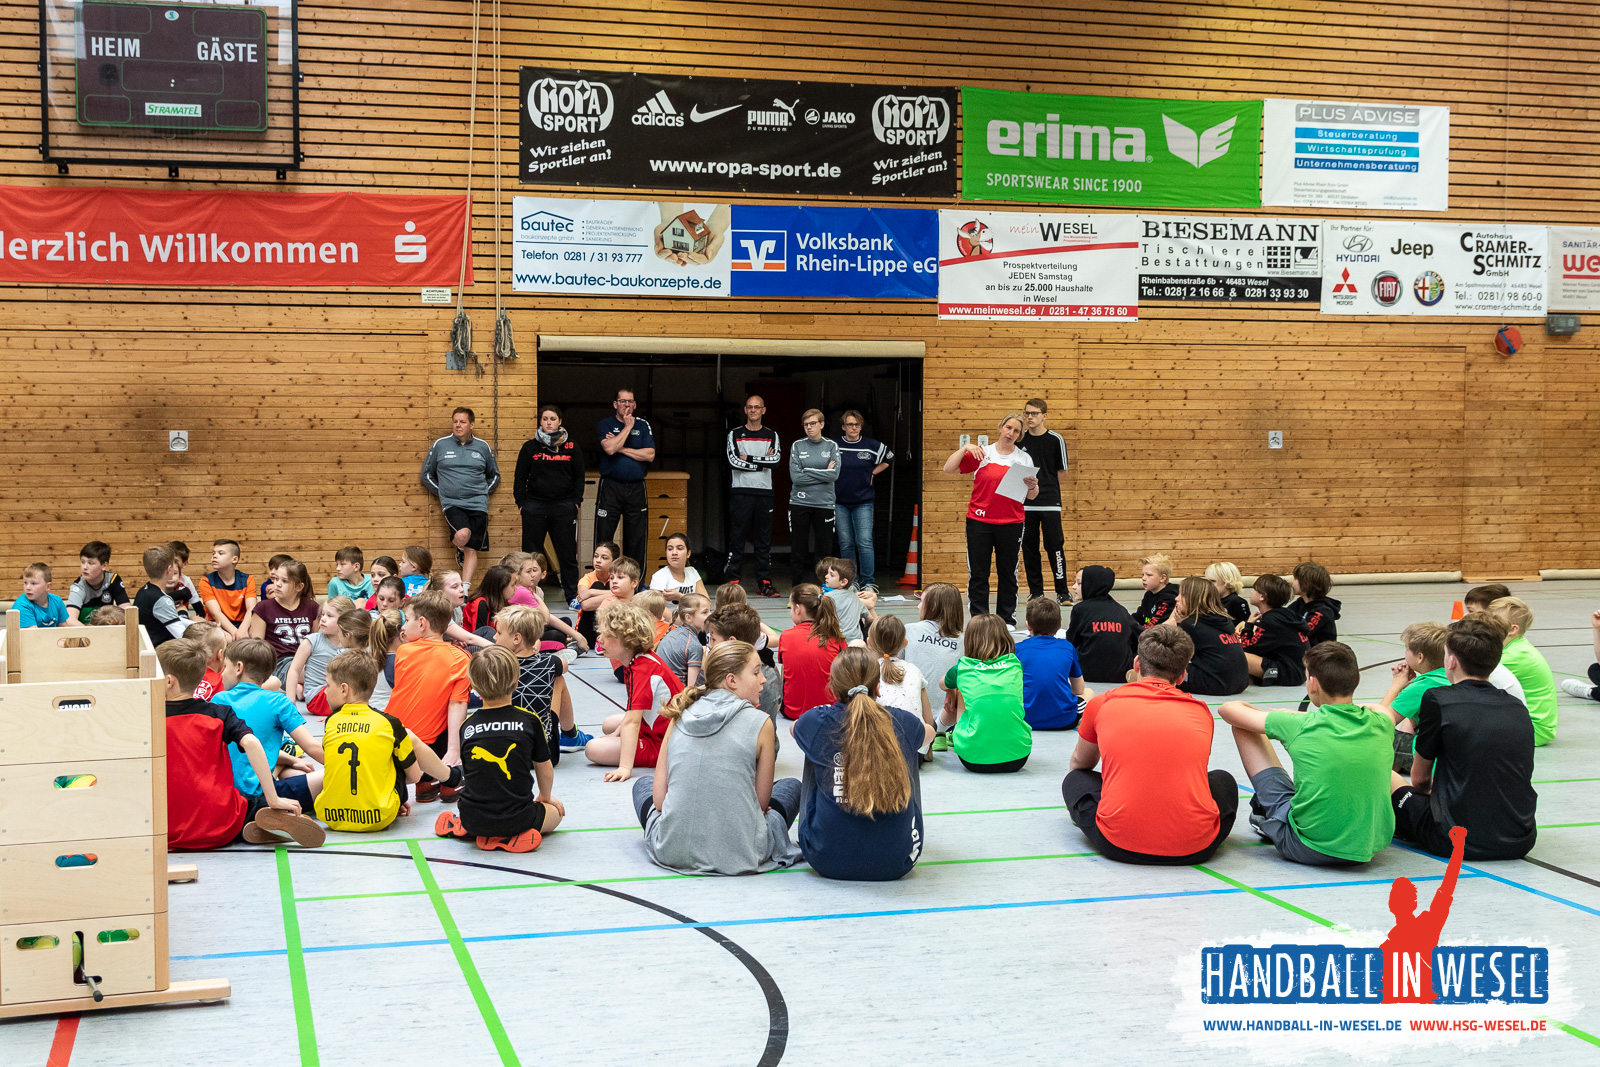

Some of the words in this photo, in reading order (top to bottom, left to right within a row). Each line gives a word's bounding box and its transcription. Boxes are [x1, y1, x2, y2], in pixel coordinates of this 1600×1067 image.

[91, 36, 141, 58] HEIM
[196, 37, 258, 63] GÄSTE
[631, 112, 684, 127] adidas
[822, 111, 856, 124] JAKO
[1299, 107, 1346, 121] PLUS
[1351, 109, 1416, 124] ADVISE
[543, 115, 598, 133] SPORT
[885, 129, 937, 146] SPORT
[986, 113, 1146, 162] erima
[1317, 129, 1398, 142] Steuerberatung
[529, 143, 558, 158] Wir
[560, 138, 606, 155] ziehen
[1307, 144, 1407, 157] Wirtschaftsprüfung
[528, 155, 587, 174] Sportler
[650, 159, 841, 179] www.ropa-sport.de
[872, 158, 900, 171] Wir
[901, 151, 943, 166] ziehen
[1296, 159, 1417, 172] Unternehmensberatung
[871, 168, 926, 185] Sportler
[927, 161, 948, 174] an!
[986, 172, 1069, 190] SPORTSWEAR
[1072, 177, 1108, 192] SINCE
[1112, 179, 1142, 193] 1900
[521, 218, 574, 234] bautec
[1009, 224, 1040, 235] mein
[1142, 220, 1320, 242] BIESEMANN
[520, 234, 556, 243] baukonzepte
[796, 232, 894, 251] Volksbank
[1460, 232, 1533, 254] CRAMER-
[0, 232, 129, 262] erzlich
[139, 233, 358, 263] Willkommen
[1390, 238, 1434, 259] Jeep
[521, 249, 558, 261] Telefon
[563, 251, 586, 262] 0281
[597, 252, 608, 262] 31
[611, 253, 623, 262] 93
[625, 253, 643, 263] 777
[1142, 257, 1264, 271] Bestattungen
[1336, 254, 1380, 263] HYUNDAI
[796, 254, 907, 276] Rhein-Lippe
[912, 257, 937, 273] eG
[1003, 261, 1078, 272] Prospektverteilung
[1473, 254, 1541, 276] SCHMITZ
[515, 272, 722, 291] www.bautec-baukonzepte.de
[1008, 272, 1036, 280] JEDEN
[1038, 273, 1073, 282] Samstag
[1142, 277, 1206, 286] Rheinbabenstraße
[1247, 279, 1269, 287] Wesel
[997, 283, 1010, 291] bis
[1024, 283, 1053, 292] 25.000
[1055, 284, 1094, 292] Haushalte
[1142, 287, 1162, 297] Tel.:
[1164, 287, 1188, 297] 0281
[1190, 288, 1197, 297] 2
[1199, 288, 1211, 297] 16
[1212, 288, 1224, 298] 66
[1229, 288, 1238, 298] &
[1245, 288, 1267, 298] 0281
[1269, 289, 1282, 298] 33
[1283, 289, 1296, 299] 93
[1297, 289, 1309, 299] 30
[1379, 281, 1397, 298] FIAT
[1023, 294, 1031, 302] in
[1033, 295, 1058, 303] Wesel
[1454, 291, 1472, 300] Tel.:
[1507, 292, 1519, 301] 98
[1521, 292, 1542, 301] 60-0
[948, 305, 1037, 315] www.meinwesel.de
[1049, 307, 1070, 316] 0281
[1078, 307, 1089, 316] 47
[1091, 307, 1102, 316] 36
[1104, 307, 1115, 316] 78
[1116, 307, 1128, 316] 60
[1455, 303, 1542, 311] www.cramer-schmitz.de
[975, 509, 986, 517] CH
[1056, 551, 1064, 579] Kempa
[1092, 621, 1122, 633] KUNO
[917, 634, 958, 650] JAKOB
[336, 722, 370, 734] SANCHO
[475, 721, 524, 734] EVONIK
[337, 742, 360, 796] 7
[324, 807, 382, 825] DORTMUND
